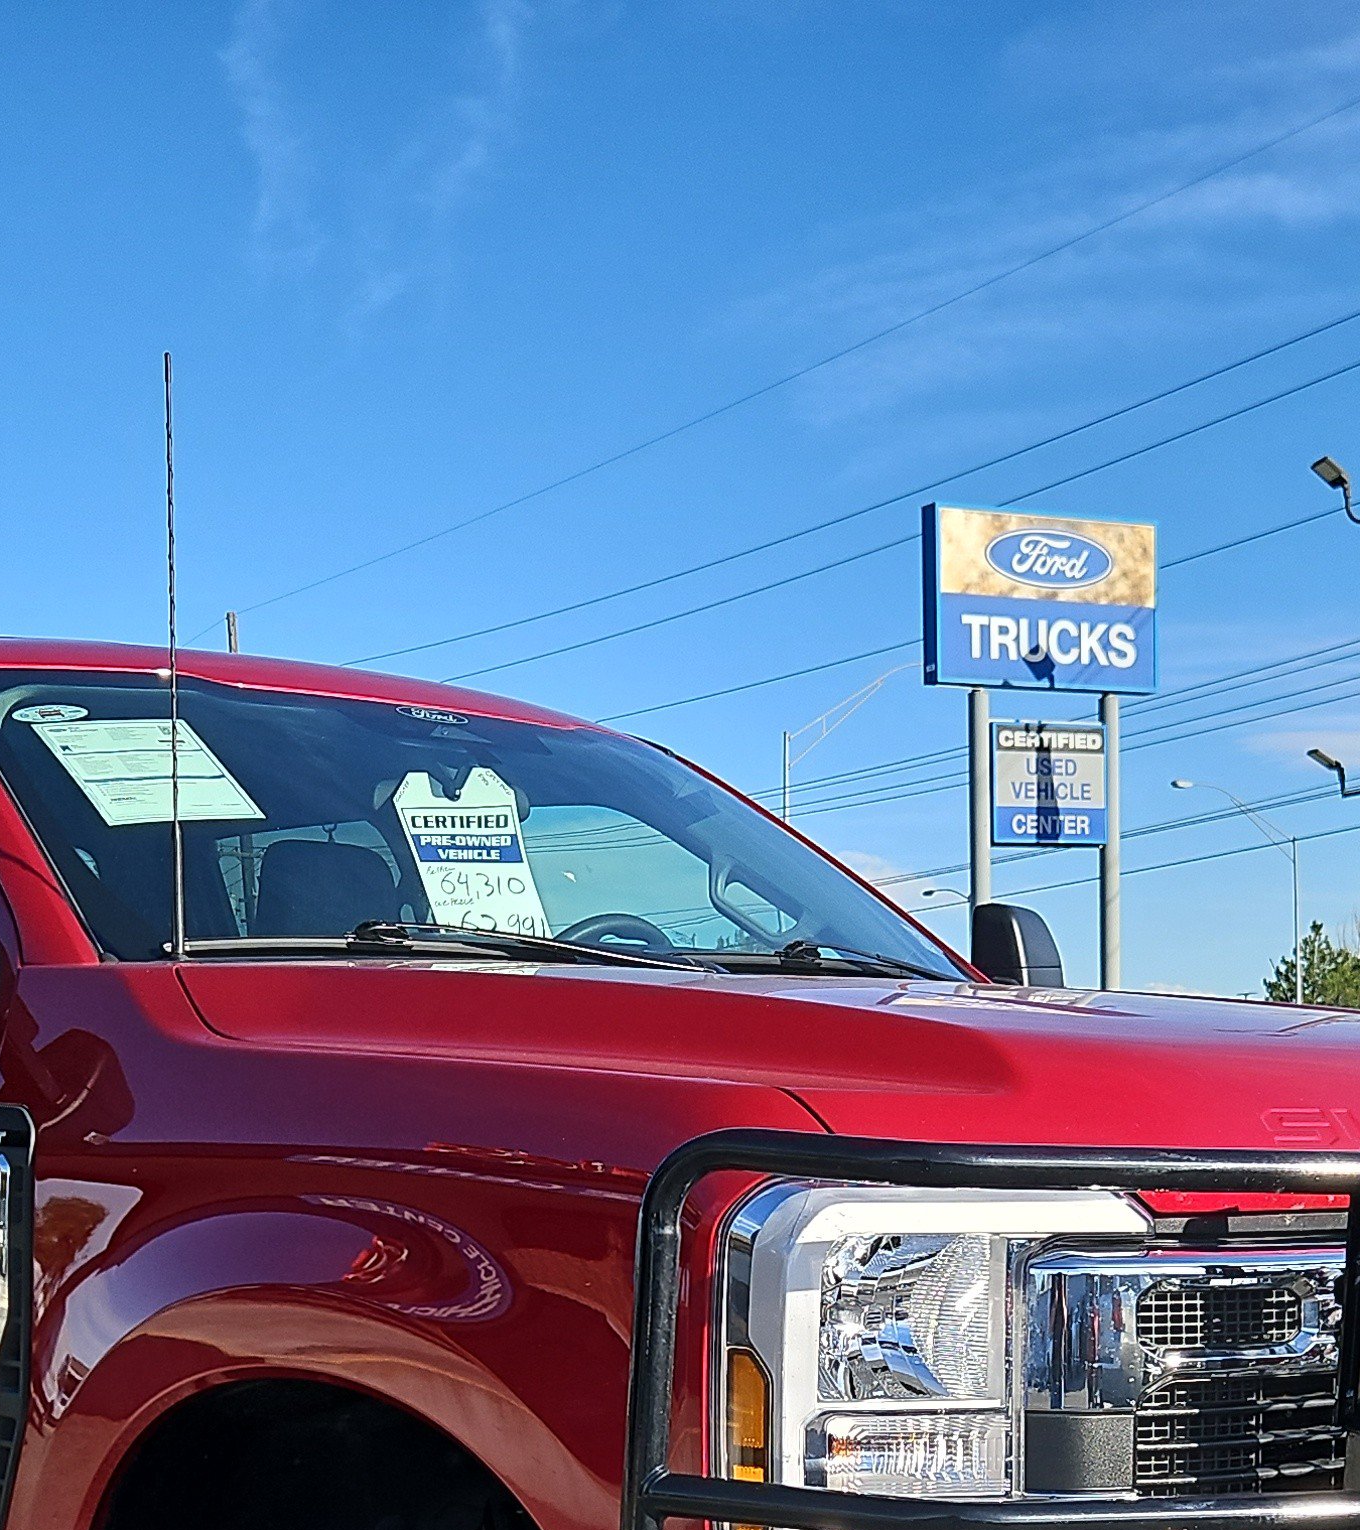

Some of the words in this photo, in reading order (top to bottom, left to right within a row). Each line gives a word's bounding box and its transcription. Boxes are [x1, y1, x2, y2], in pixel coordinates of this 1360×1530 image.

[1011, 535, 1089, 580] Ford
[961, 613, 1138, 668] TRUCKS
[998, 731, 1103, 750] CERTIFIED
[1026, 758, 1077, 778] USED
[1011, 781, 1092, 801] VEHICLE
[410, 814, 509, 829] CERTIFIED
[1011, 814, 1090, 835] CENTER
[419, 835, 512, 847] PRE-OWNED
[437, 849, 501, 860] VEHICLE
[440, 871, 526, 899] 64,310
